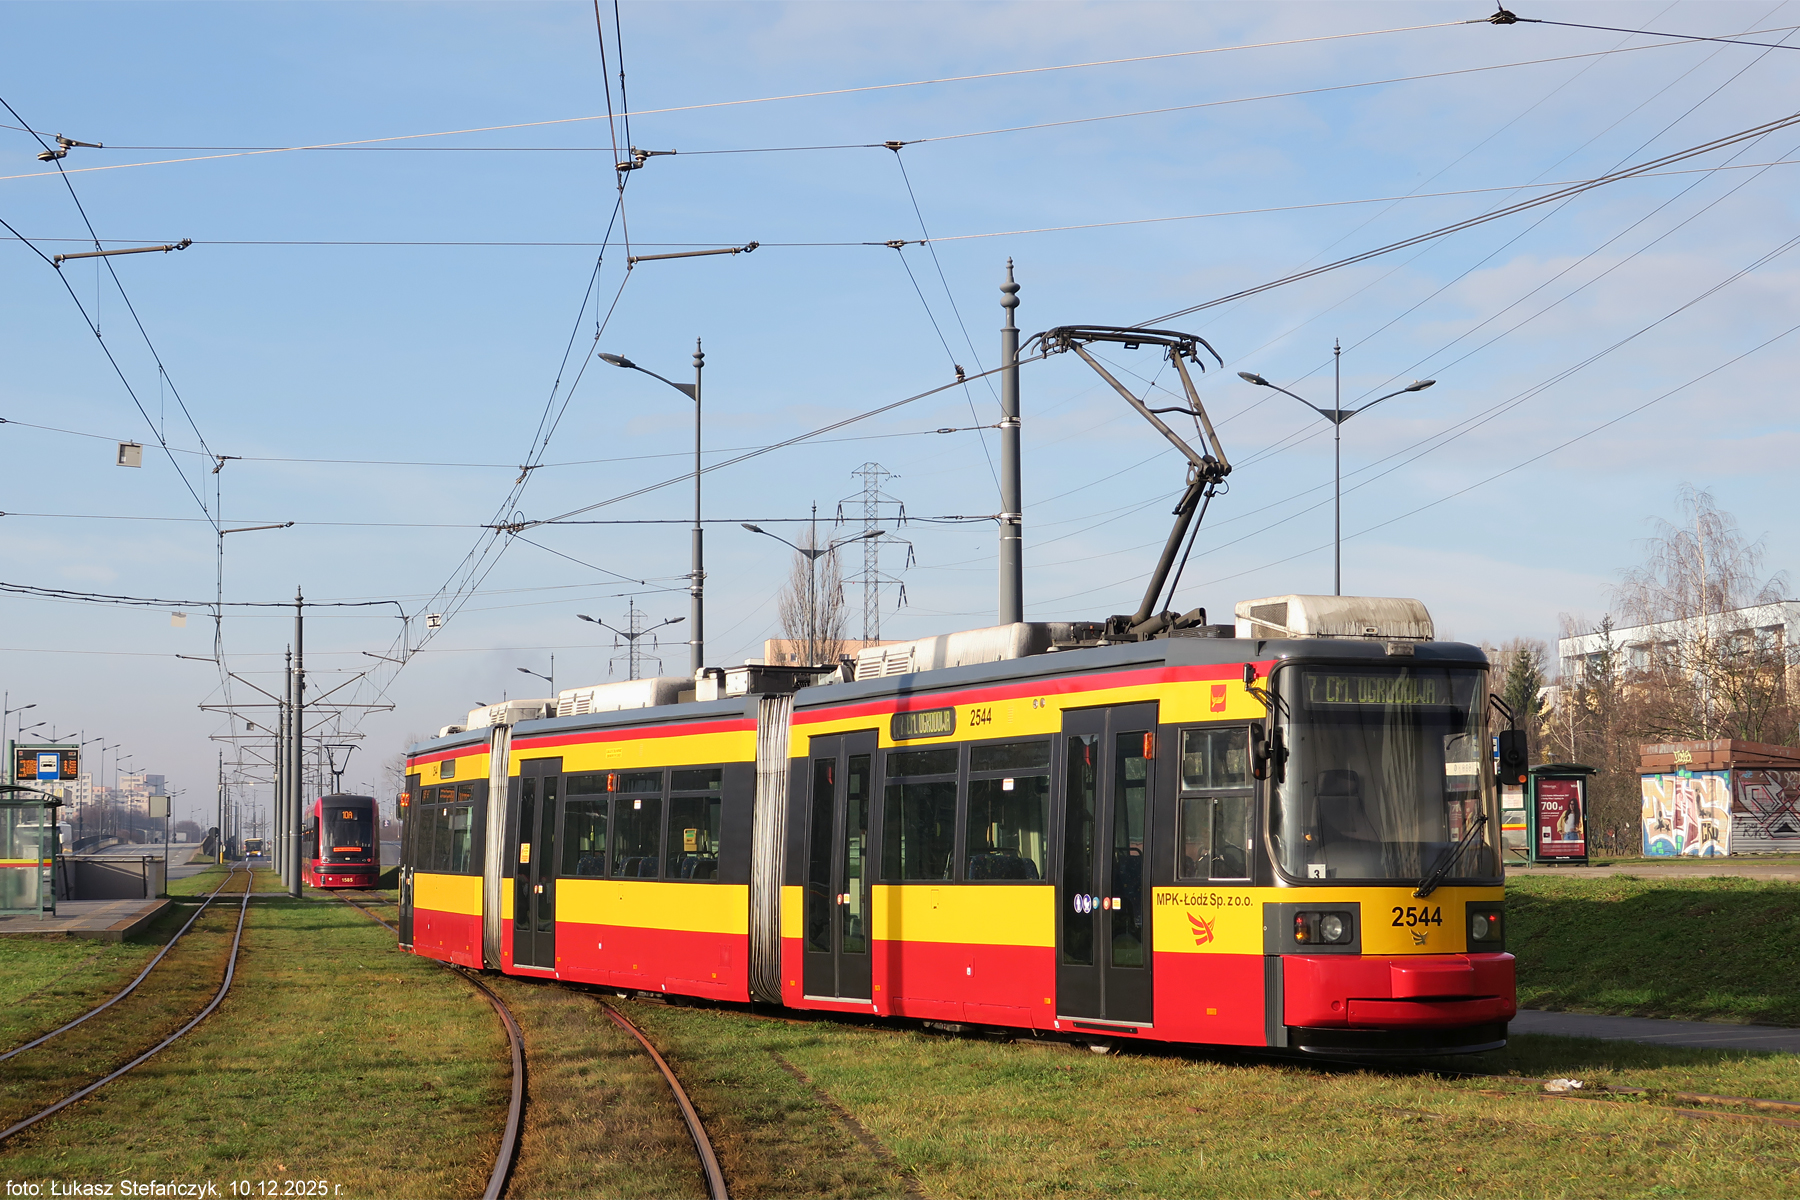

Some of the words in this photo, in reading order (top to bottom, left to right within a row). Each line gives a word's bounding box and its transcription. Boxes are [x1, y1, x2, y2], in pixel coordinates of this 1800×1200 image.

[1308, 676, 1317, 702] 7
[1326, 676, 1352, 702] CM.
[1358, 677, 1435, 704] OGRODOWA
[970, 707, 992, 727] 2544
[342, 810, 353, 819] 10A
[1541, 801, 1558, 811] 700
[1314, 869, 1320, 879] 3
[1156, 892, 1208, 906] MPK-Łódź
[1210, 893, 1226, 909] Sp.
[1227, 896, 1233, 906] z
[1235, 896, 1254, 907] o.o.
[1391, 906, 1443, 927] 2544
